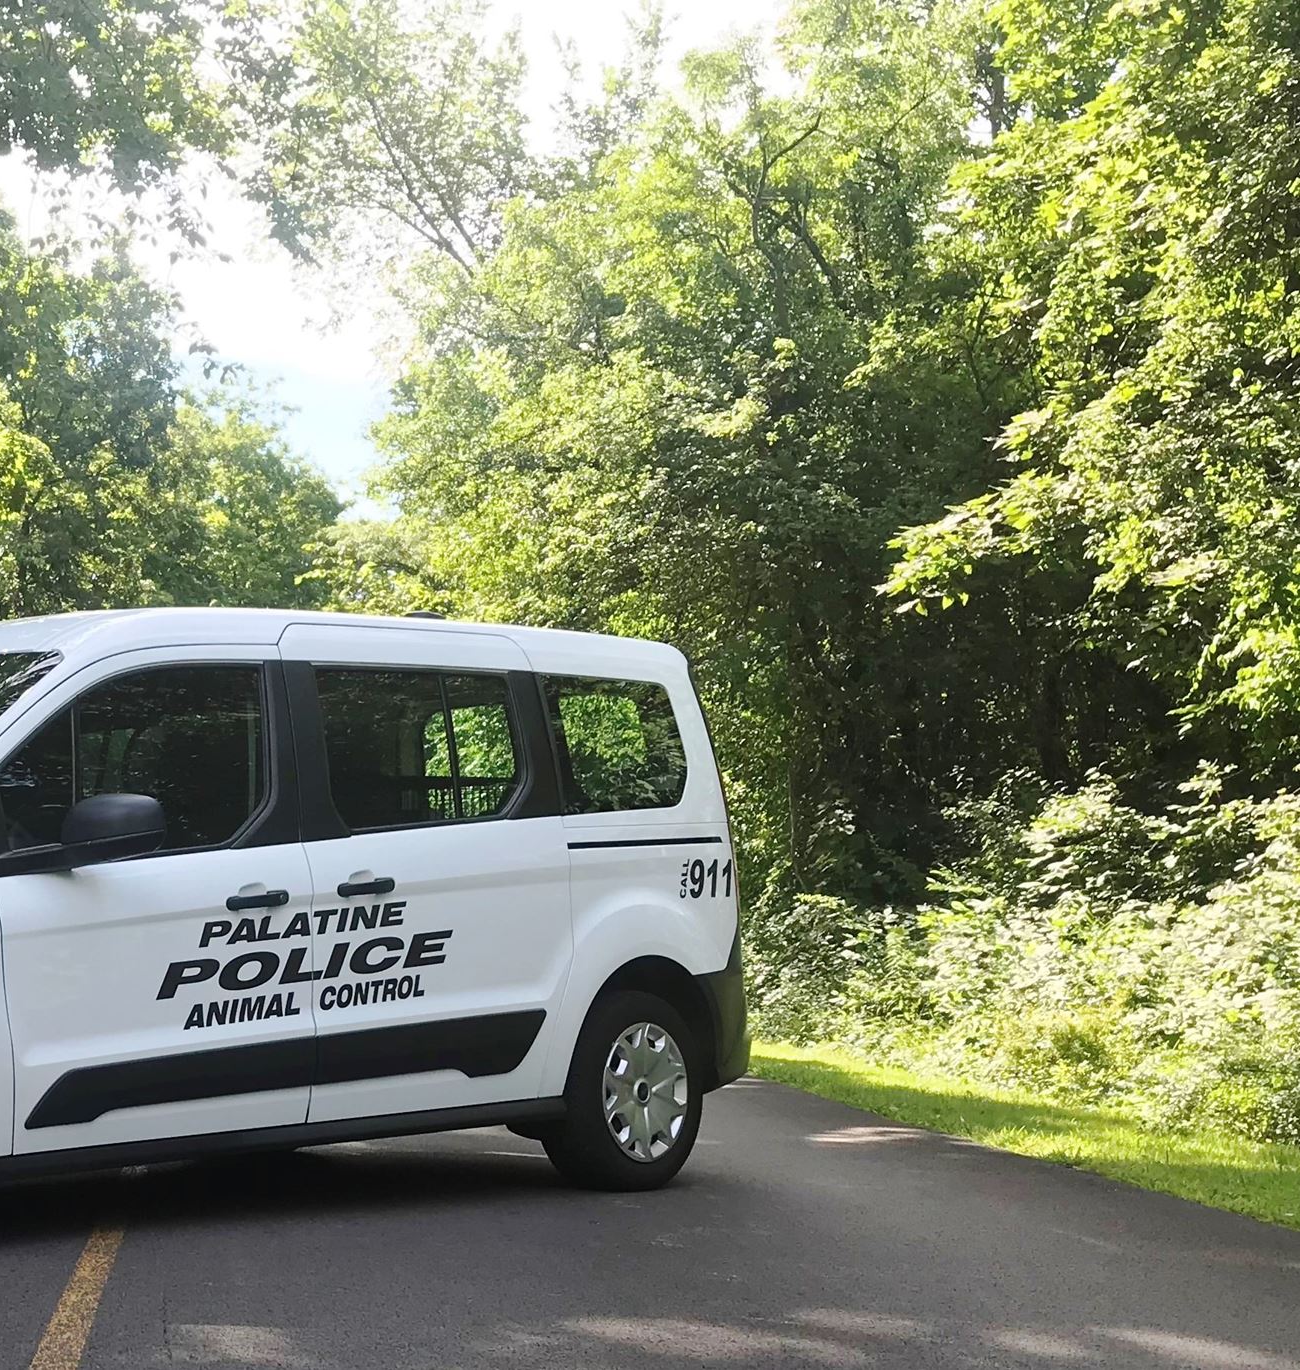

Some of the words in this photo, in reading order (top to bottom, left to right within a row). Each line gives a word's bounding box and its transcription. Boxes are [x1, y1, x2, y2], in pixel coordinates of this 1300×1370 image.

[680, 859, 690, 899] CALL
[690, 858, 732, 899] 911
[199, 901, 407, 948] PALATINE
[156, 930, 454, 1000] POLICE
[183, 992, 301, 1031] ANIMAL
[319, 974, 425, 1011] CONTROL
